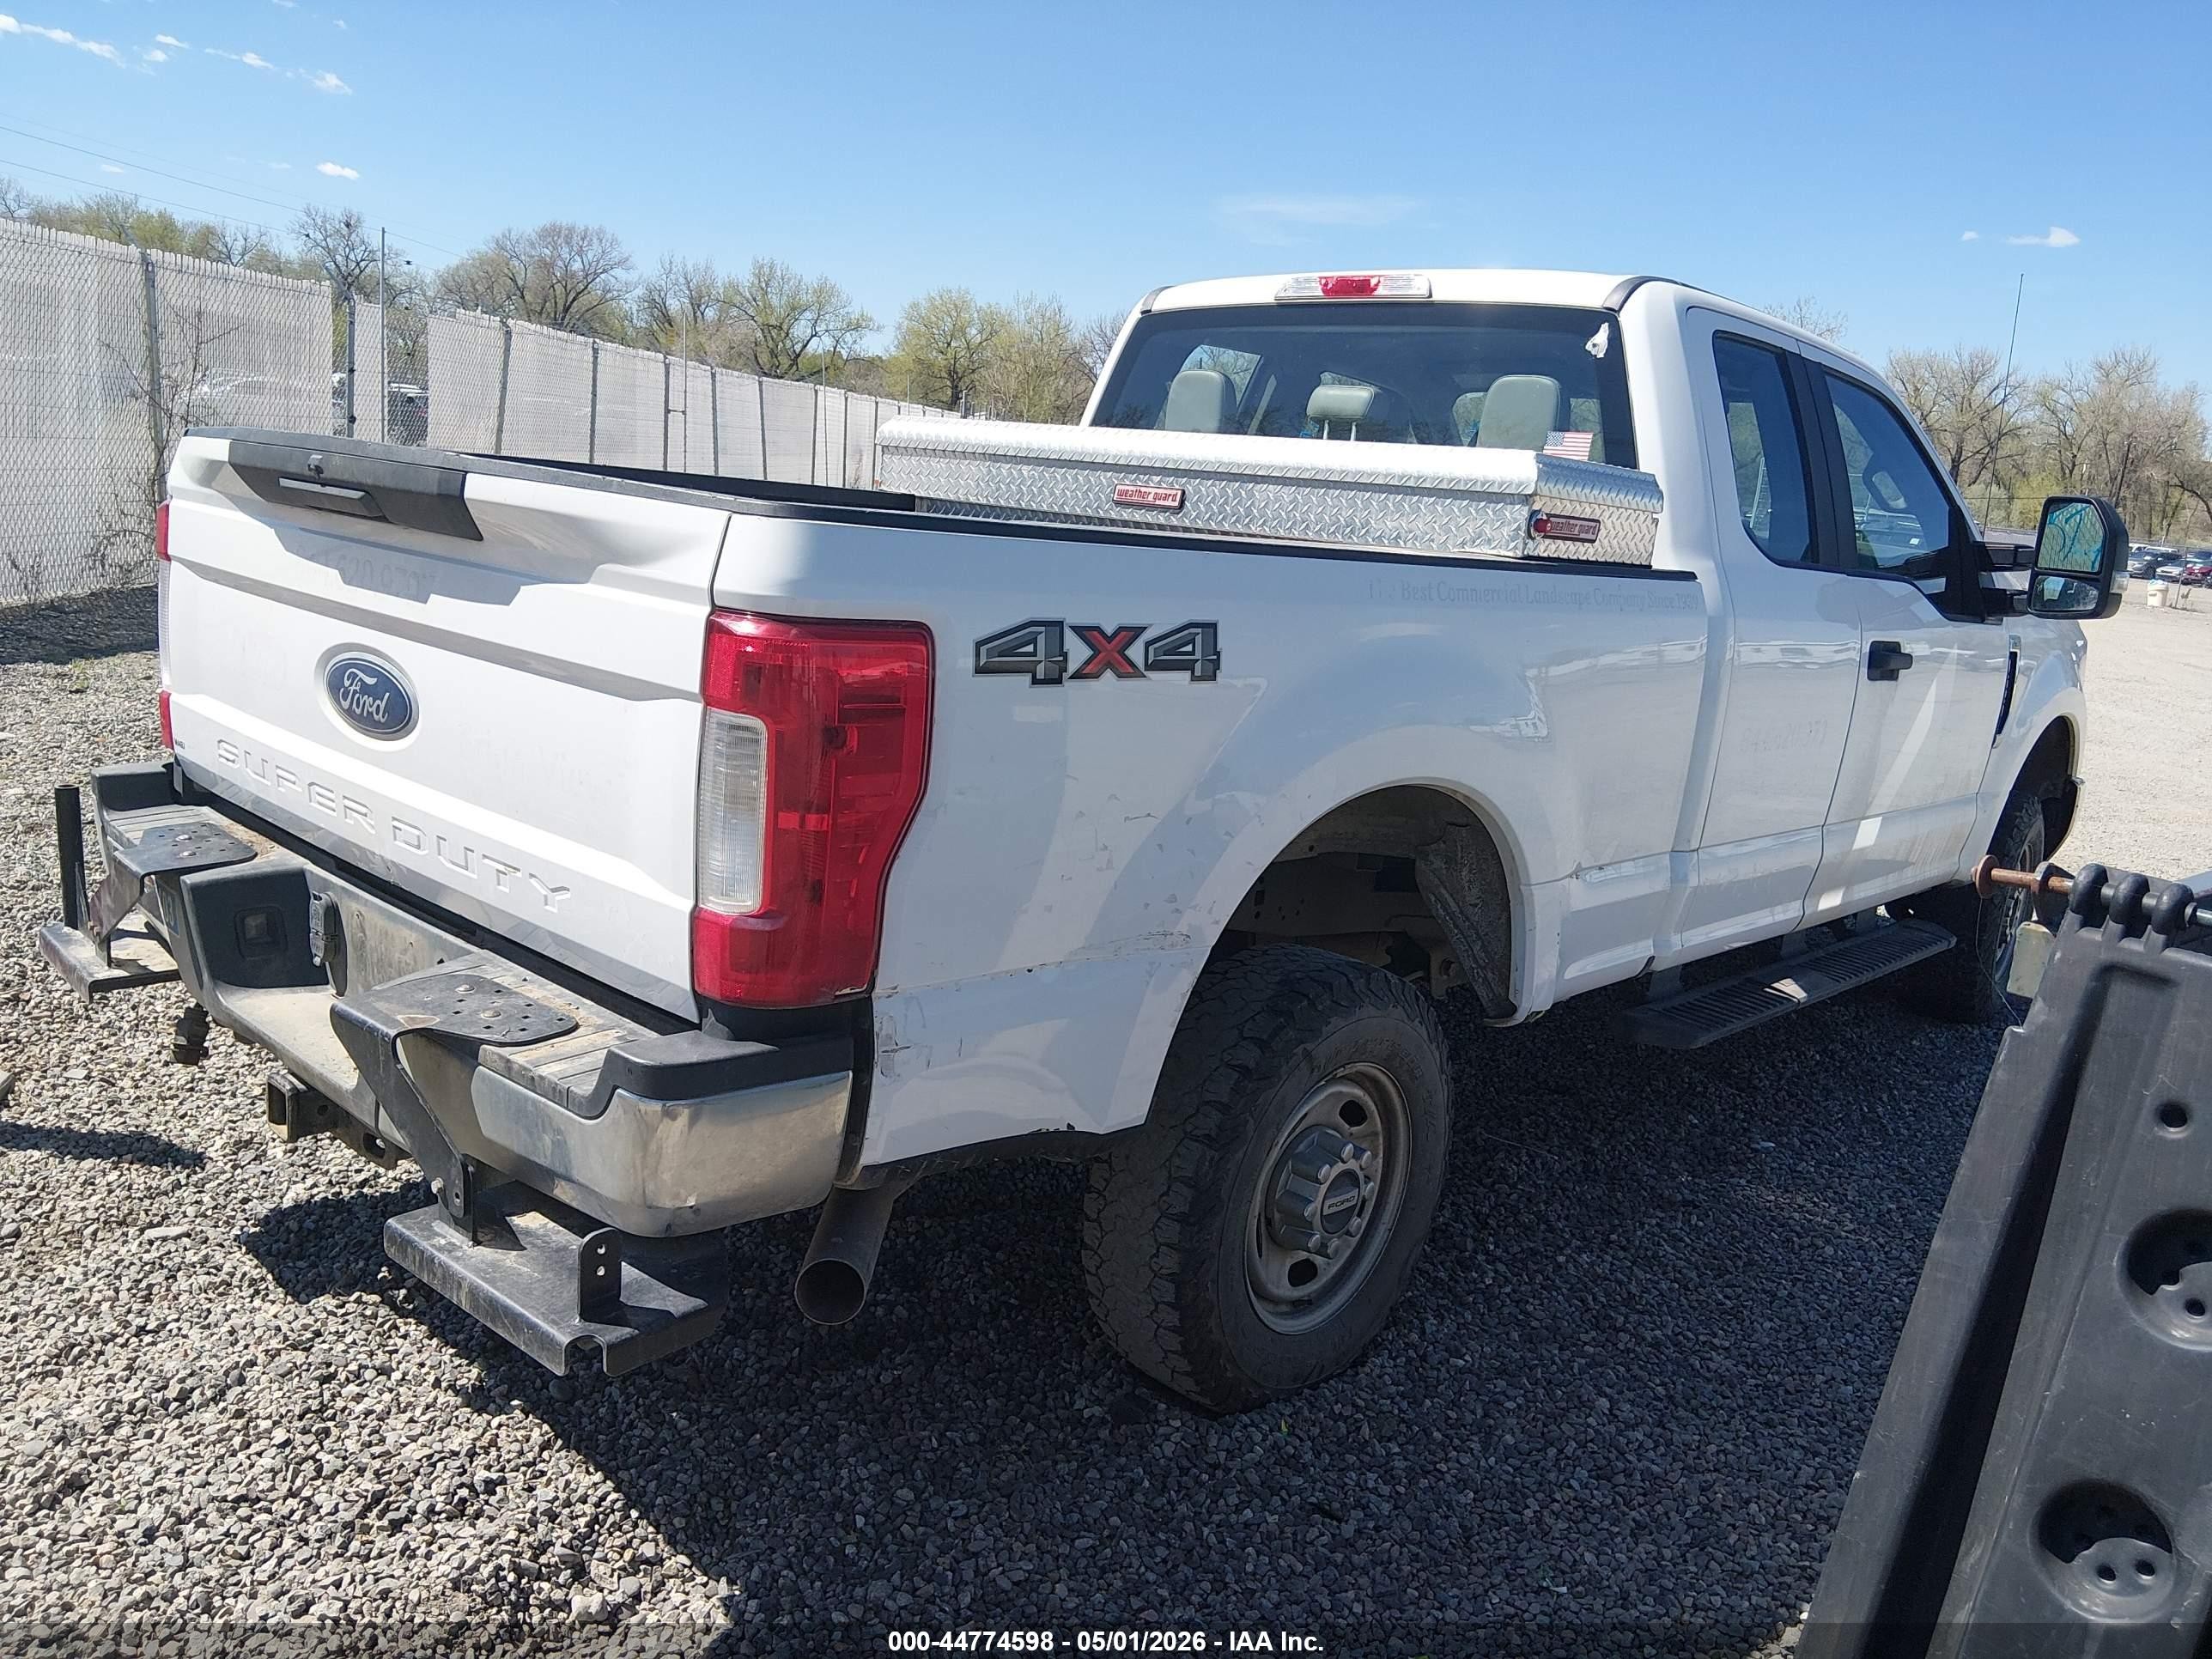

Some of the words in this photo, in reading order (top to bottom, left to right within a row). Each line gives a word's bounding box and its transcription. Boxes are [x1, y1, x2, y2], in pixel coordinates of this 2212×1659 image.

[1116, 488, 1152, 500] weather
[1152, 490, 1178, 502] guard
[1578, 523, 1597, 536] guard
[1401, 580, 1435, 601] Best
[1437, 580, 1523, 605] Commercial
[1525, 584, 1592, 610] Landscape
[339, 667, 391, 723] Ford
[216, 738, 377, 835] SUPER
[391, 815, 571, 913] DUTY
[1328, 1195, 1356, 1210] FORD
